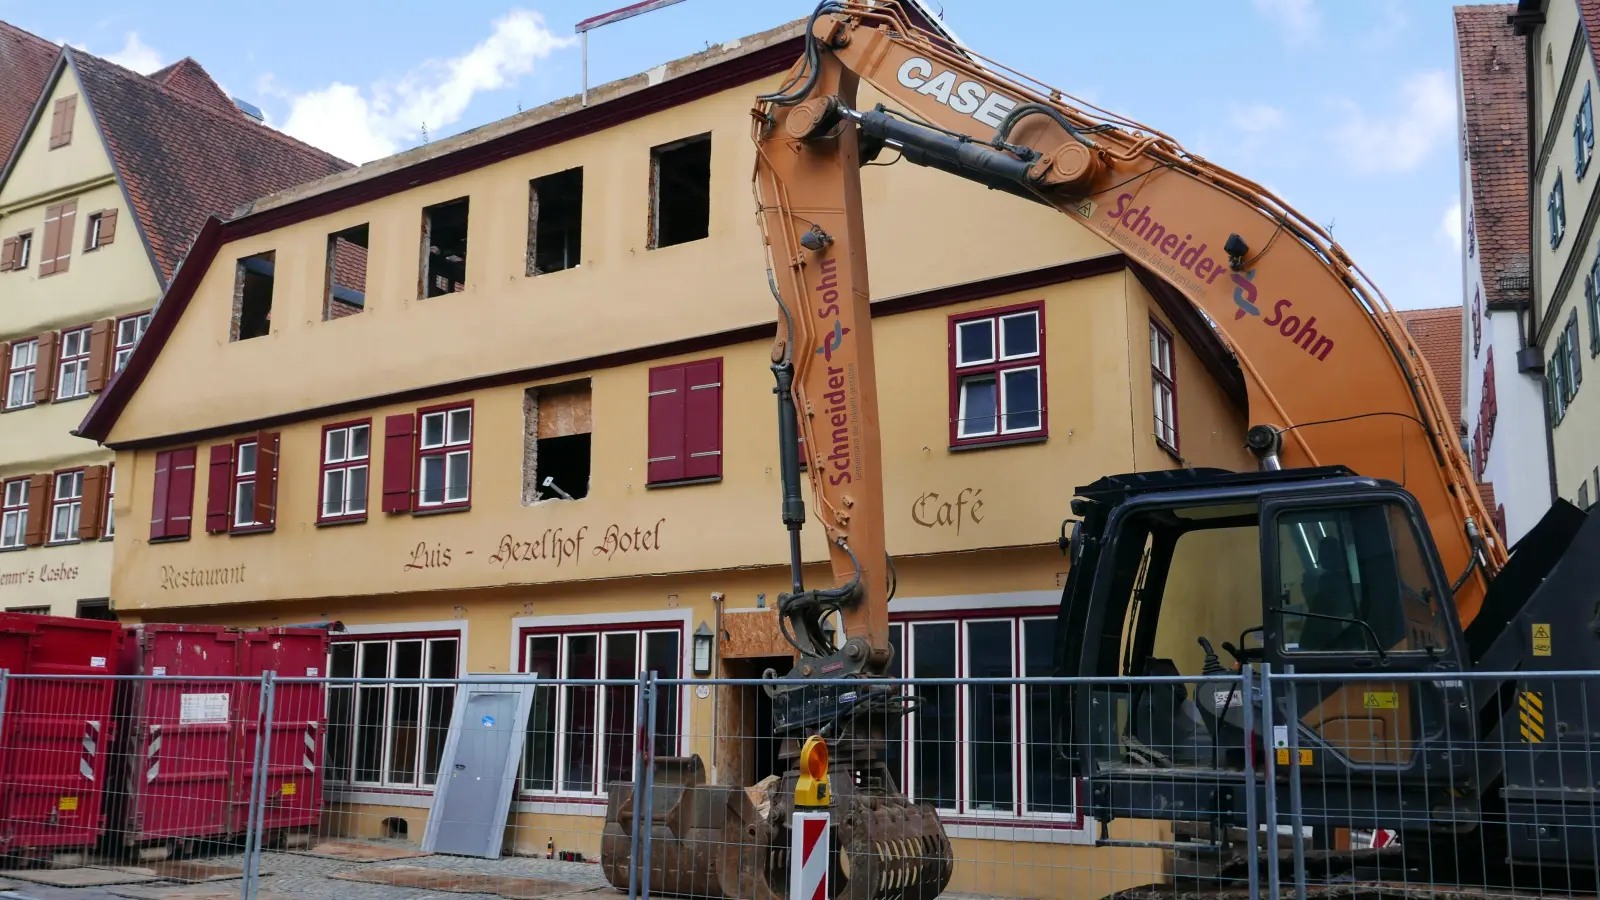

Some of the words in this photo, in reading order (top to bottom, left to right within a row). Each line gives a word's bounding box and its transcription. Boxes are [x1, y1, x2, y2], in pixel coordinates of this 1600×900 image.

[897, 56, 1020, 129] CASE
[816, 258, 840, 320] Sohn
[1107, 193, 1226, 285] Schneider
[1263, 299, 1335, 362] Sohn
[824, 366, 852, 487] Schneider
[911, 487, 985, 537] Café
[160, 562, 246, 590] Restaurant
[404, 541, 452, 572] Luis
[488, 525, 589, 569] Hezelhof
[592, 518, 666, 562] Hotel
